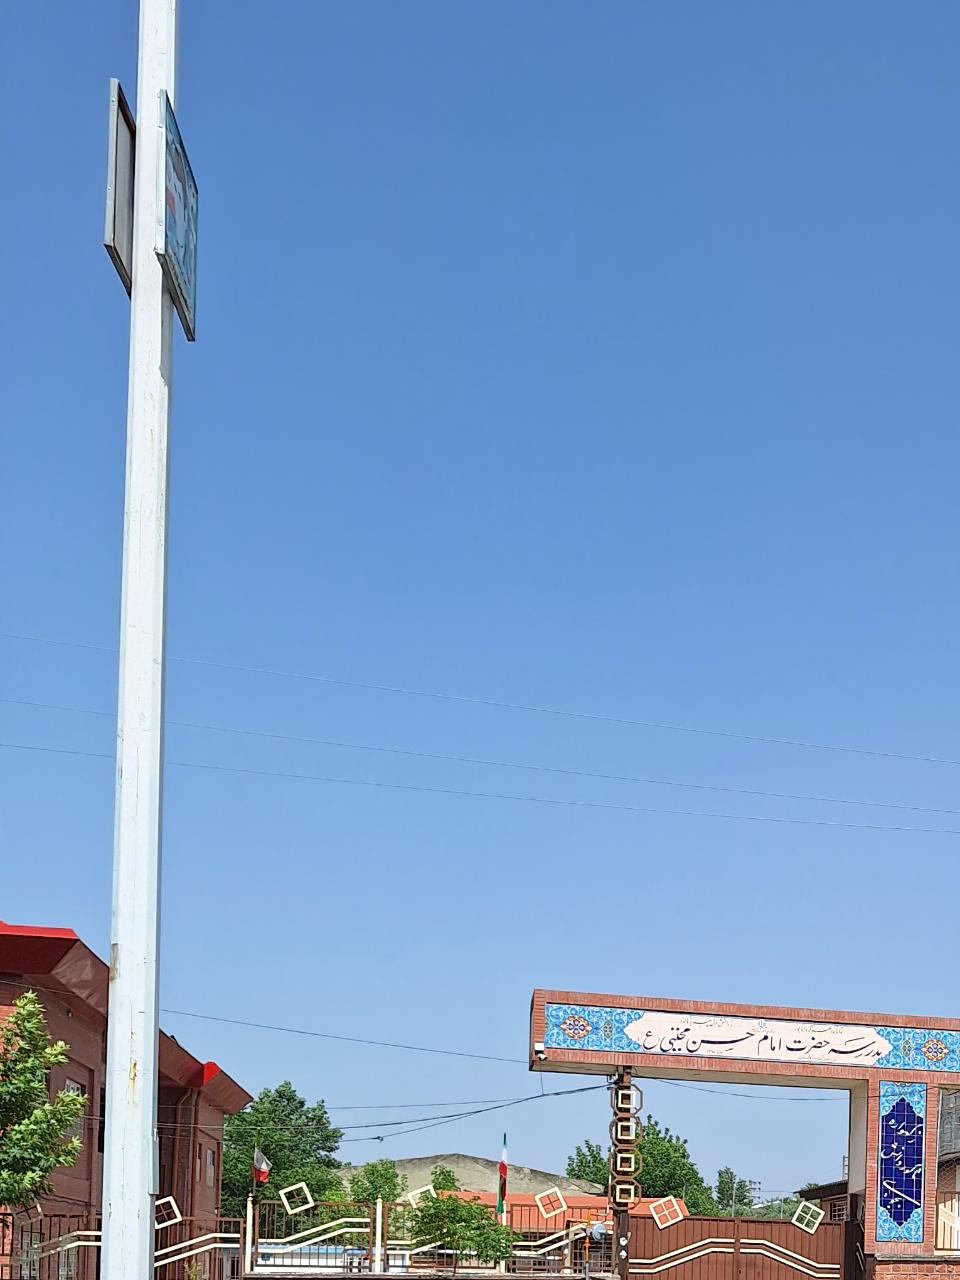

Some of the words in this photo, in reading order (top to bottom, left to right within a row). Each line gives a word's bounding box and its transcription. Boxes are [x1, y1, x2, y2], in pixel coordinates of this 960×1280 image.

[660, 1027, 691, 1052] مجتبی
[685, 1031, 755, 1053] حسن
[757, 1034, 782, 1056] امام
[785, 1036, 830, 1055] حضرت
[828, 1036, 882, 1058] مدرسه
